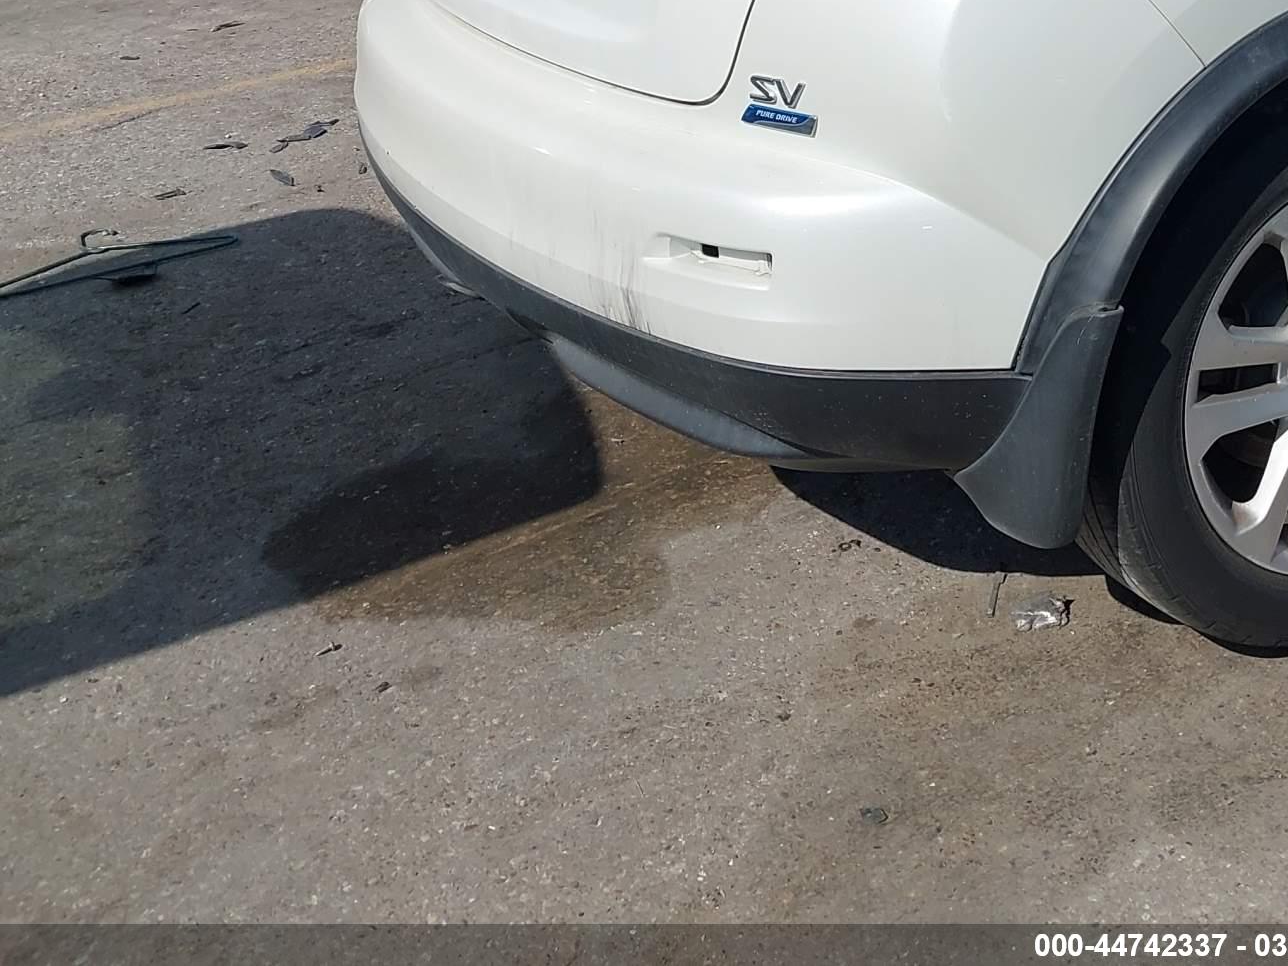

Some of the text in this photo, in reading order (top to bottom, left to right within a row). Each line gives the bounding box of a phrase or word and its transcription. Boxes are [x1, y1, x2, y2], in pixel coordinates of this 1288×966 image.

[750, 75, 806, 109] SV
[756, 110, 798, 124] PURE DRIVE
